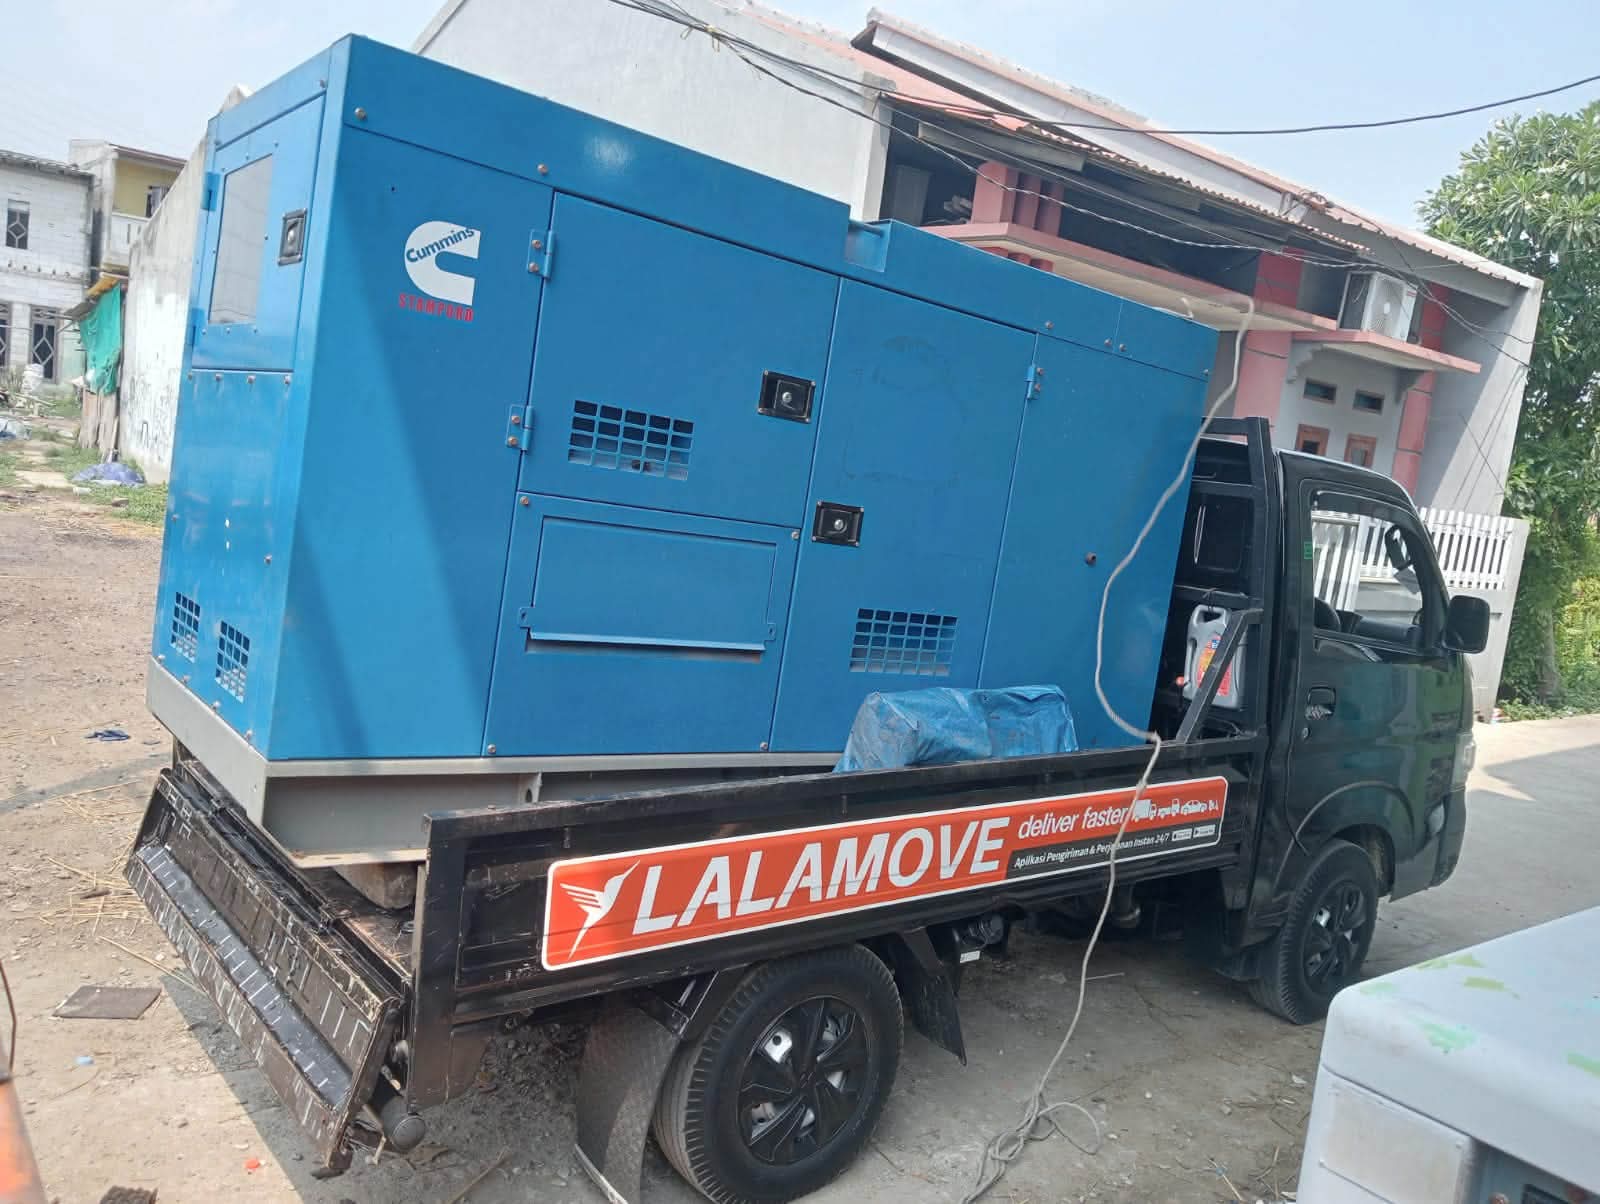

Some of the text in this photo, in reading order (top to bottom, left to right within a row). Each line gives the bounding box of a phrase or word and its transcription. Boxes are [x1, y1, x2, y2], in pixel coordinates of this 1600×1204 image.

[406, 228, 475, 262] Cummins
[1018, 806, 1128, 839] deliver faster
[1014, 852, 1046, 869] Aplikasi
[1046, 847, 1089, 862] Pengiriman
[1089, 845, 1096, 855] &
[1096, 839, 1133, 854] Perjanan
[1155, 832, 1170, 845] 24/7
[632, 817, 1010, 935] LALAMOVE
